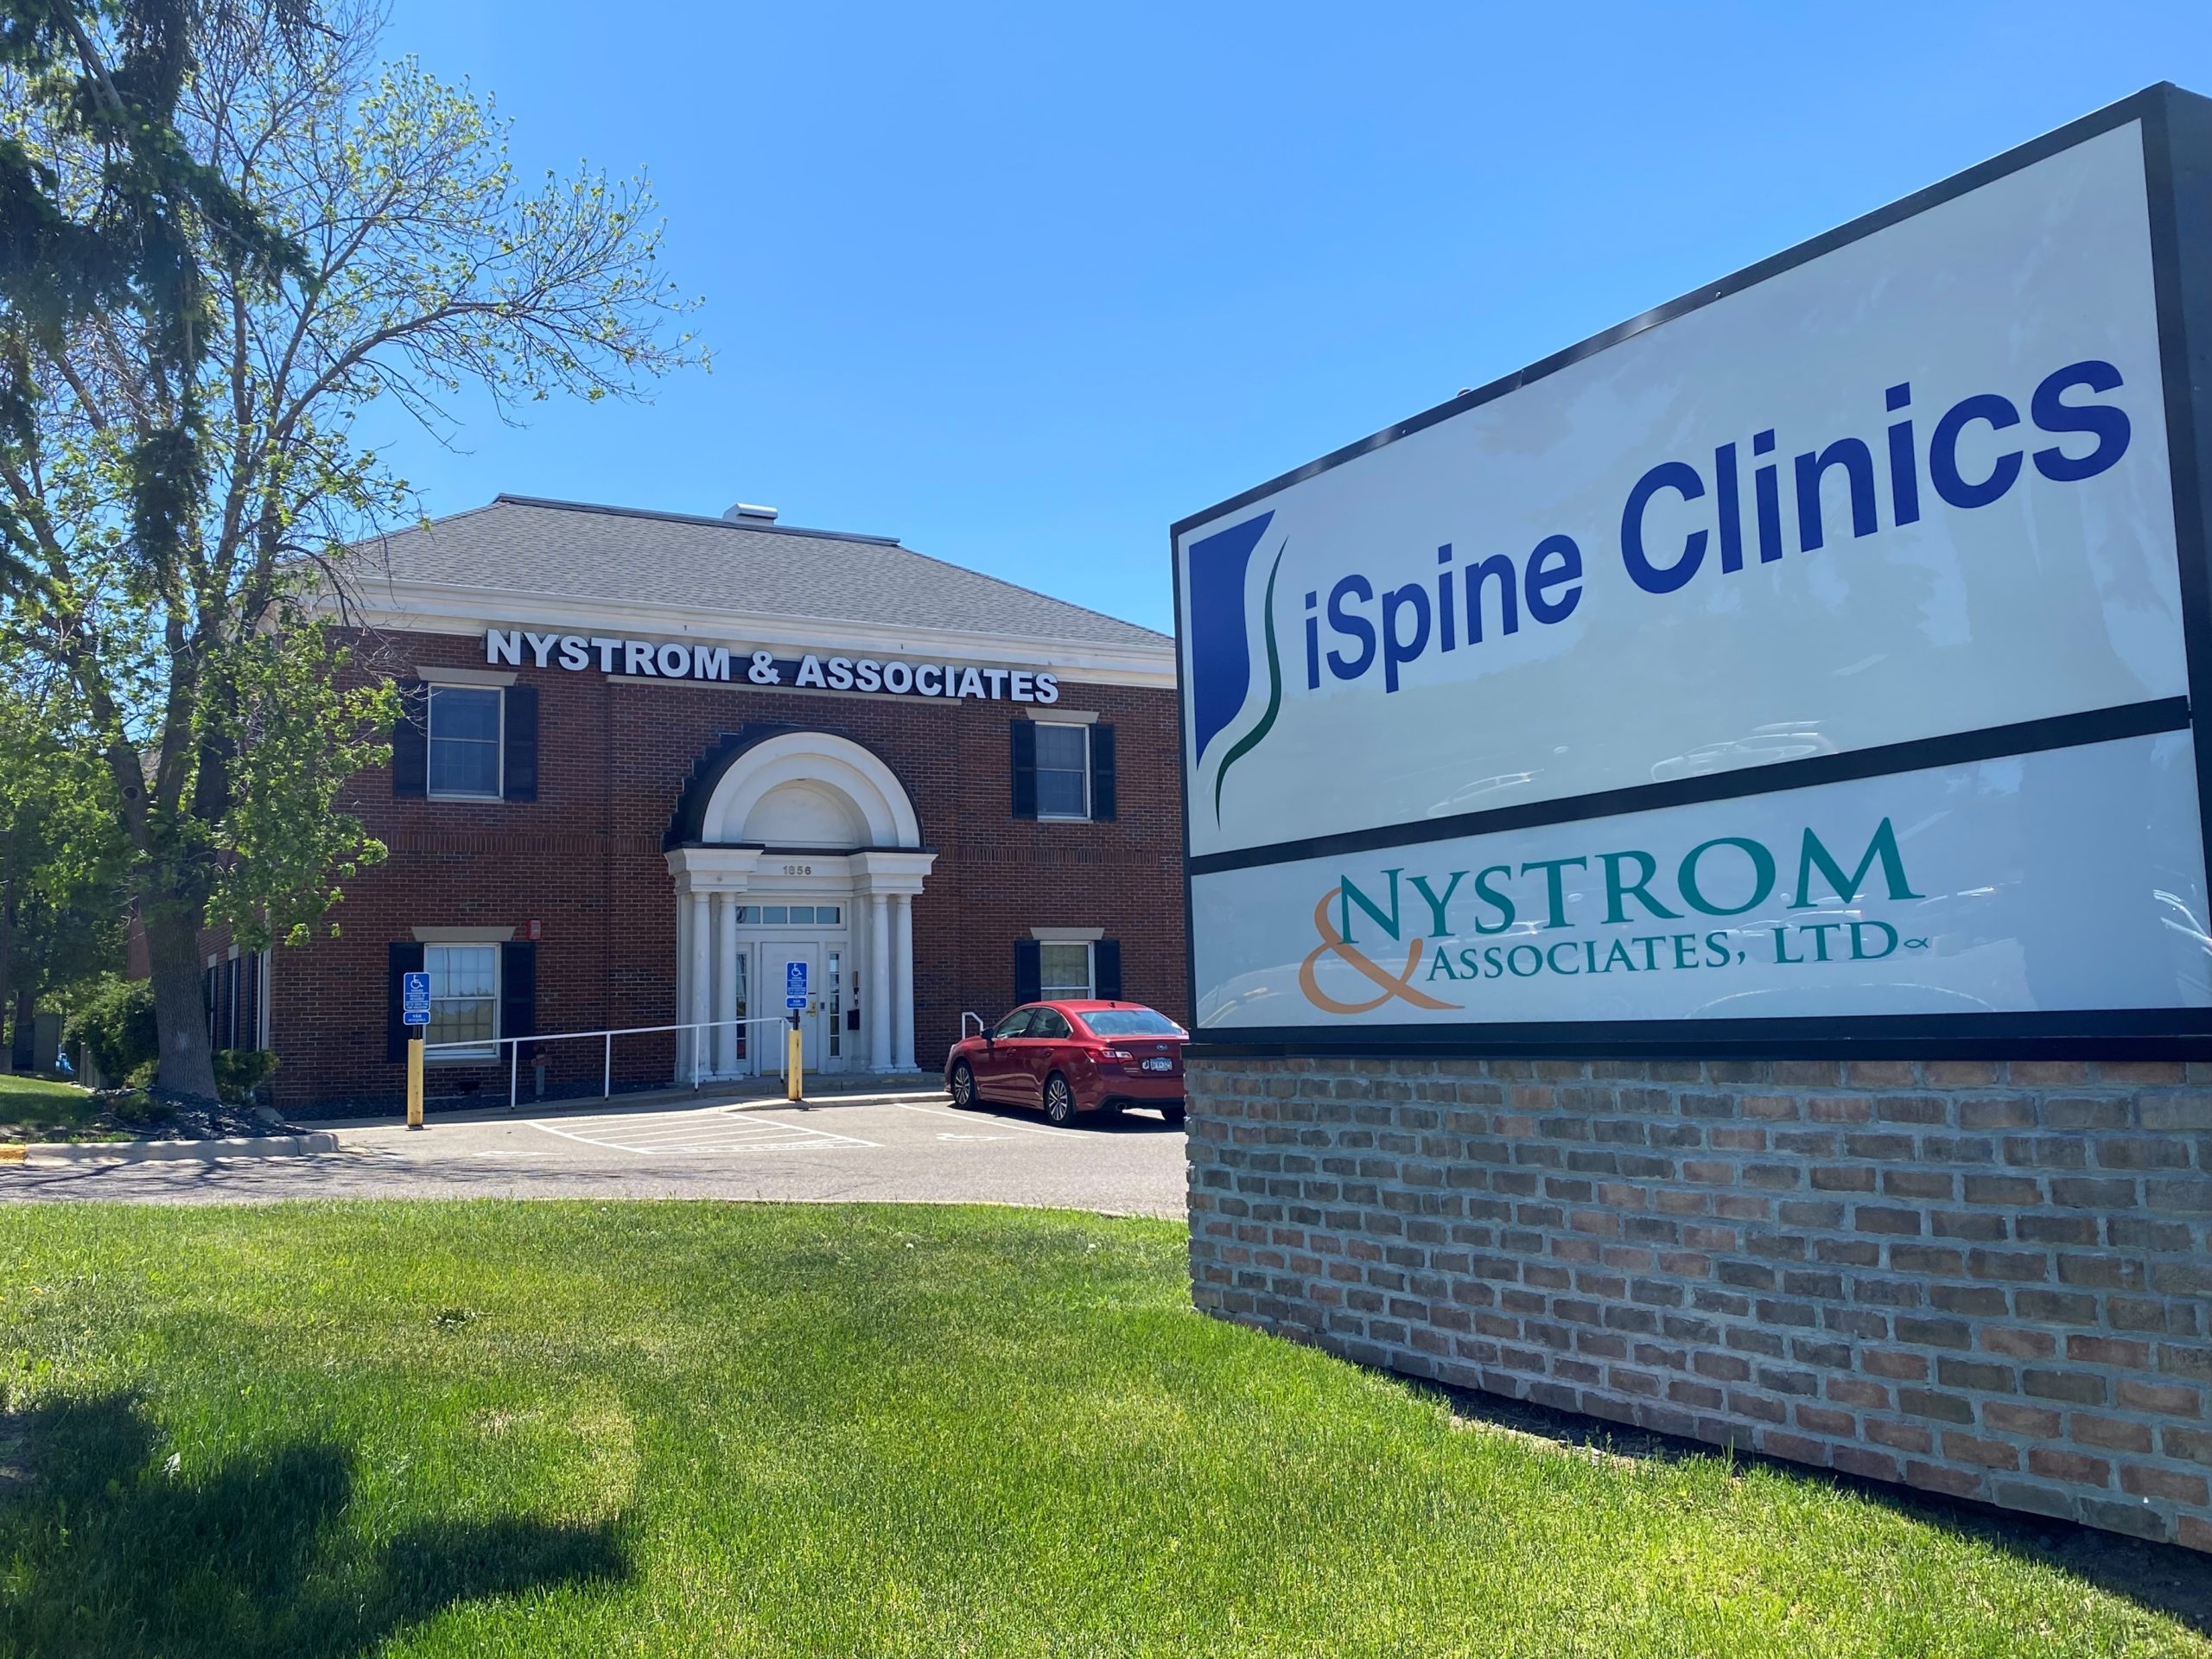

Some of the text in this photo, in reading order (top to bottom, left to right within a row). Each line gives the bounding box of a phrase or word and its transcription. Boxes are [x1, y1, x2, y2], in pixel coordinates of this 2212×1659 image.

[1306, 360, 2132, 694] iSpine Clinics
[486, 628, 1059, 704] NYSTROM & ASSOCIATES
[782, 865, 812, 875] 1856
[1338, 817, 1926, 945] NYSTROM
[1299, 887, 1900, 1014] & ASSOCIATES, LTD
